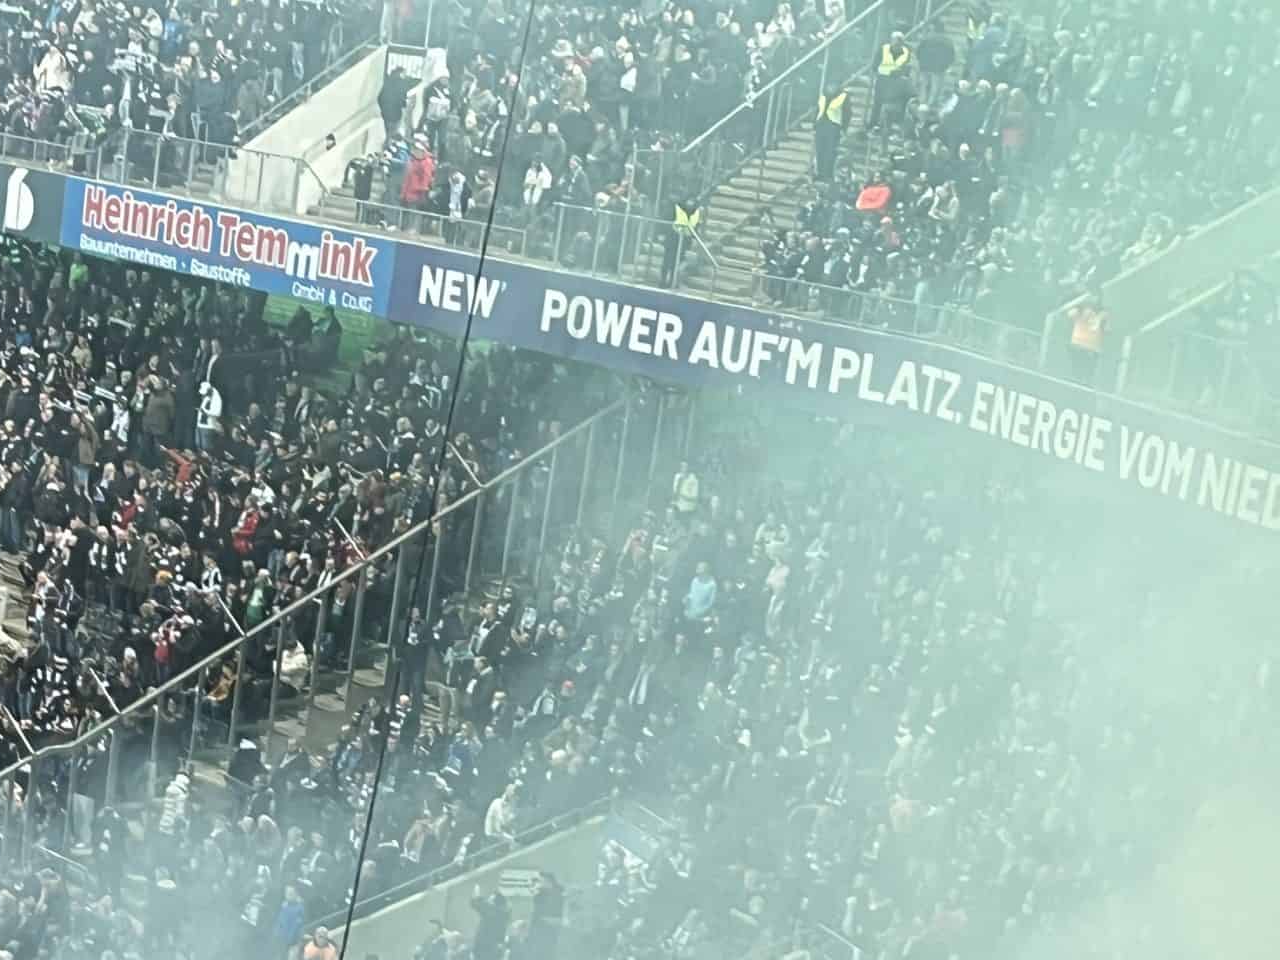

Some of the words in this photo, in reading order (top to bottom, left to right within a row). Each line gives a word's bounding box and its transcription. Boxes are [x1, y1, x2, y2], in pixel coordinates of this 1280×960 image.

[82, 184, 213, 252] Heinrich
[217, 211, 378, 287] Temmink
[190, 259, 251, 287] Baustoffe
[292, 281, 326, 303] GmbH
[540, 289, 683, 360] POWER
[688, 321, 823, 389] AUF'M
[969, 381, 1112, 472] ENERGIE
[1119, 425, 1196, 501] VOM
